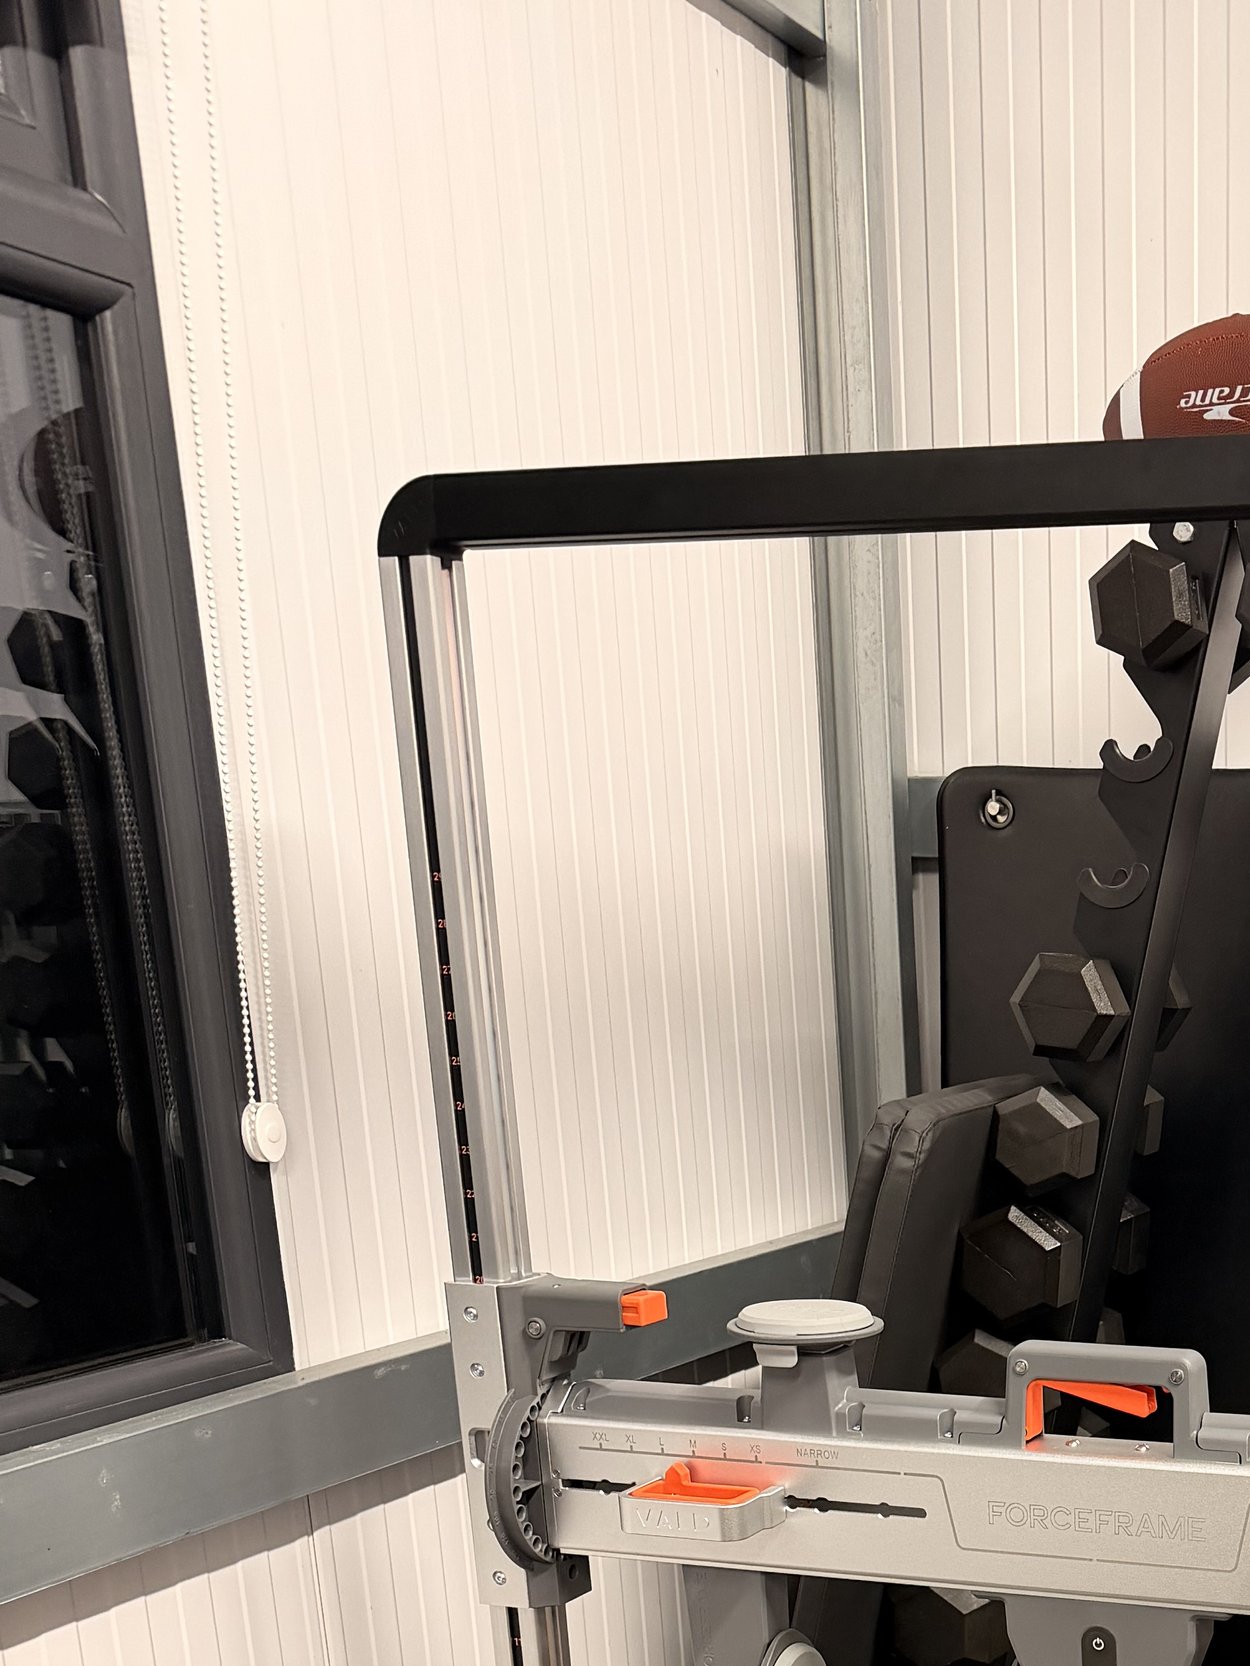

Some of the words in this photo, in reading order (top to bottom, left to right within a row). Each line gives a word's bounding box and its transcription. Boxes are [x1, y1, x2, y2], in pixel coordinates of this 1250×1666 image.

[592, 1431, 610, 1443] XXL
[625, 1434, 637, 1444] XL
[658, 1436, 664, 1447] L
[689, 1439, 697, 1449] M
[721, 1442, 727, 1451] S
[749, 1444, 762, 1454] XS
[796, 1448, 839, 1460] NARROW
[987, 1500, 1207, 1543] FORCEFRAME
